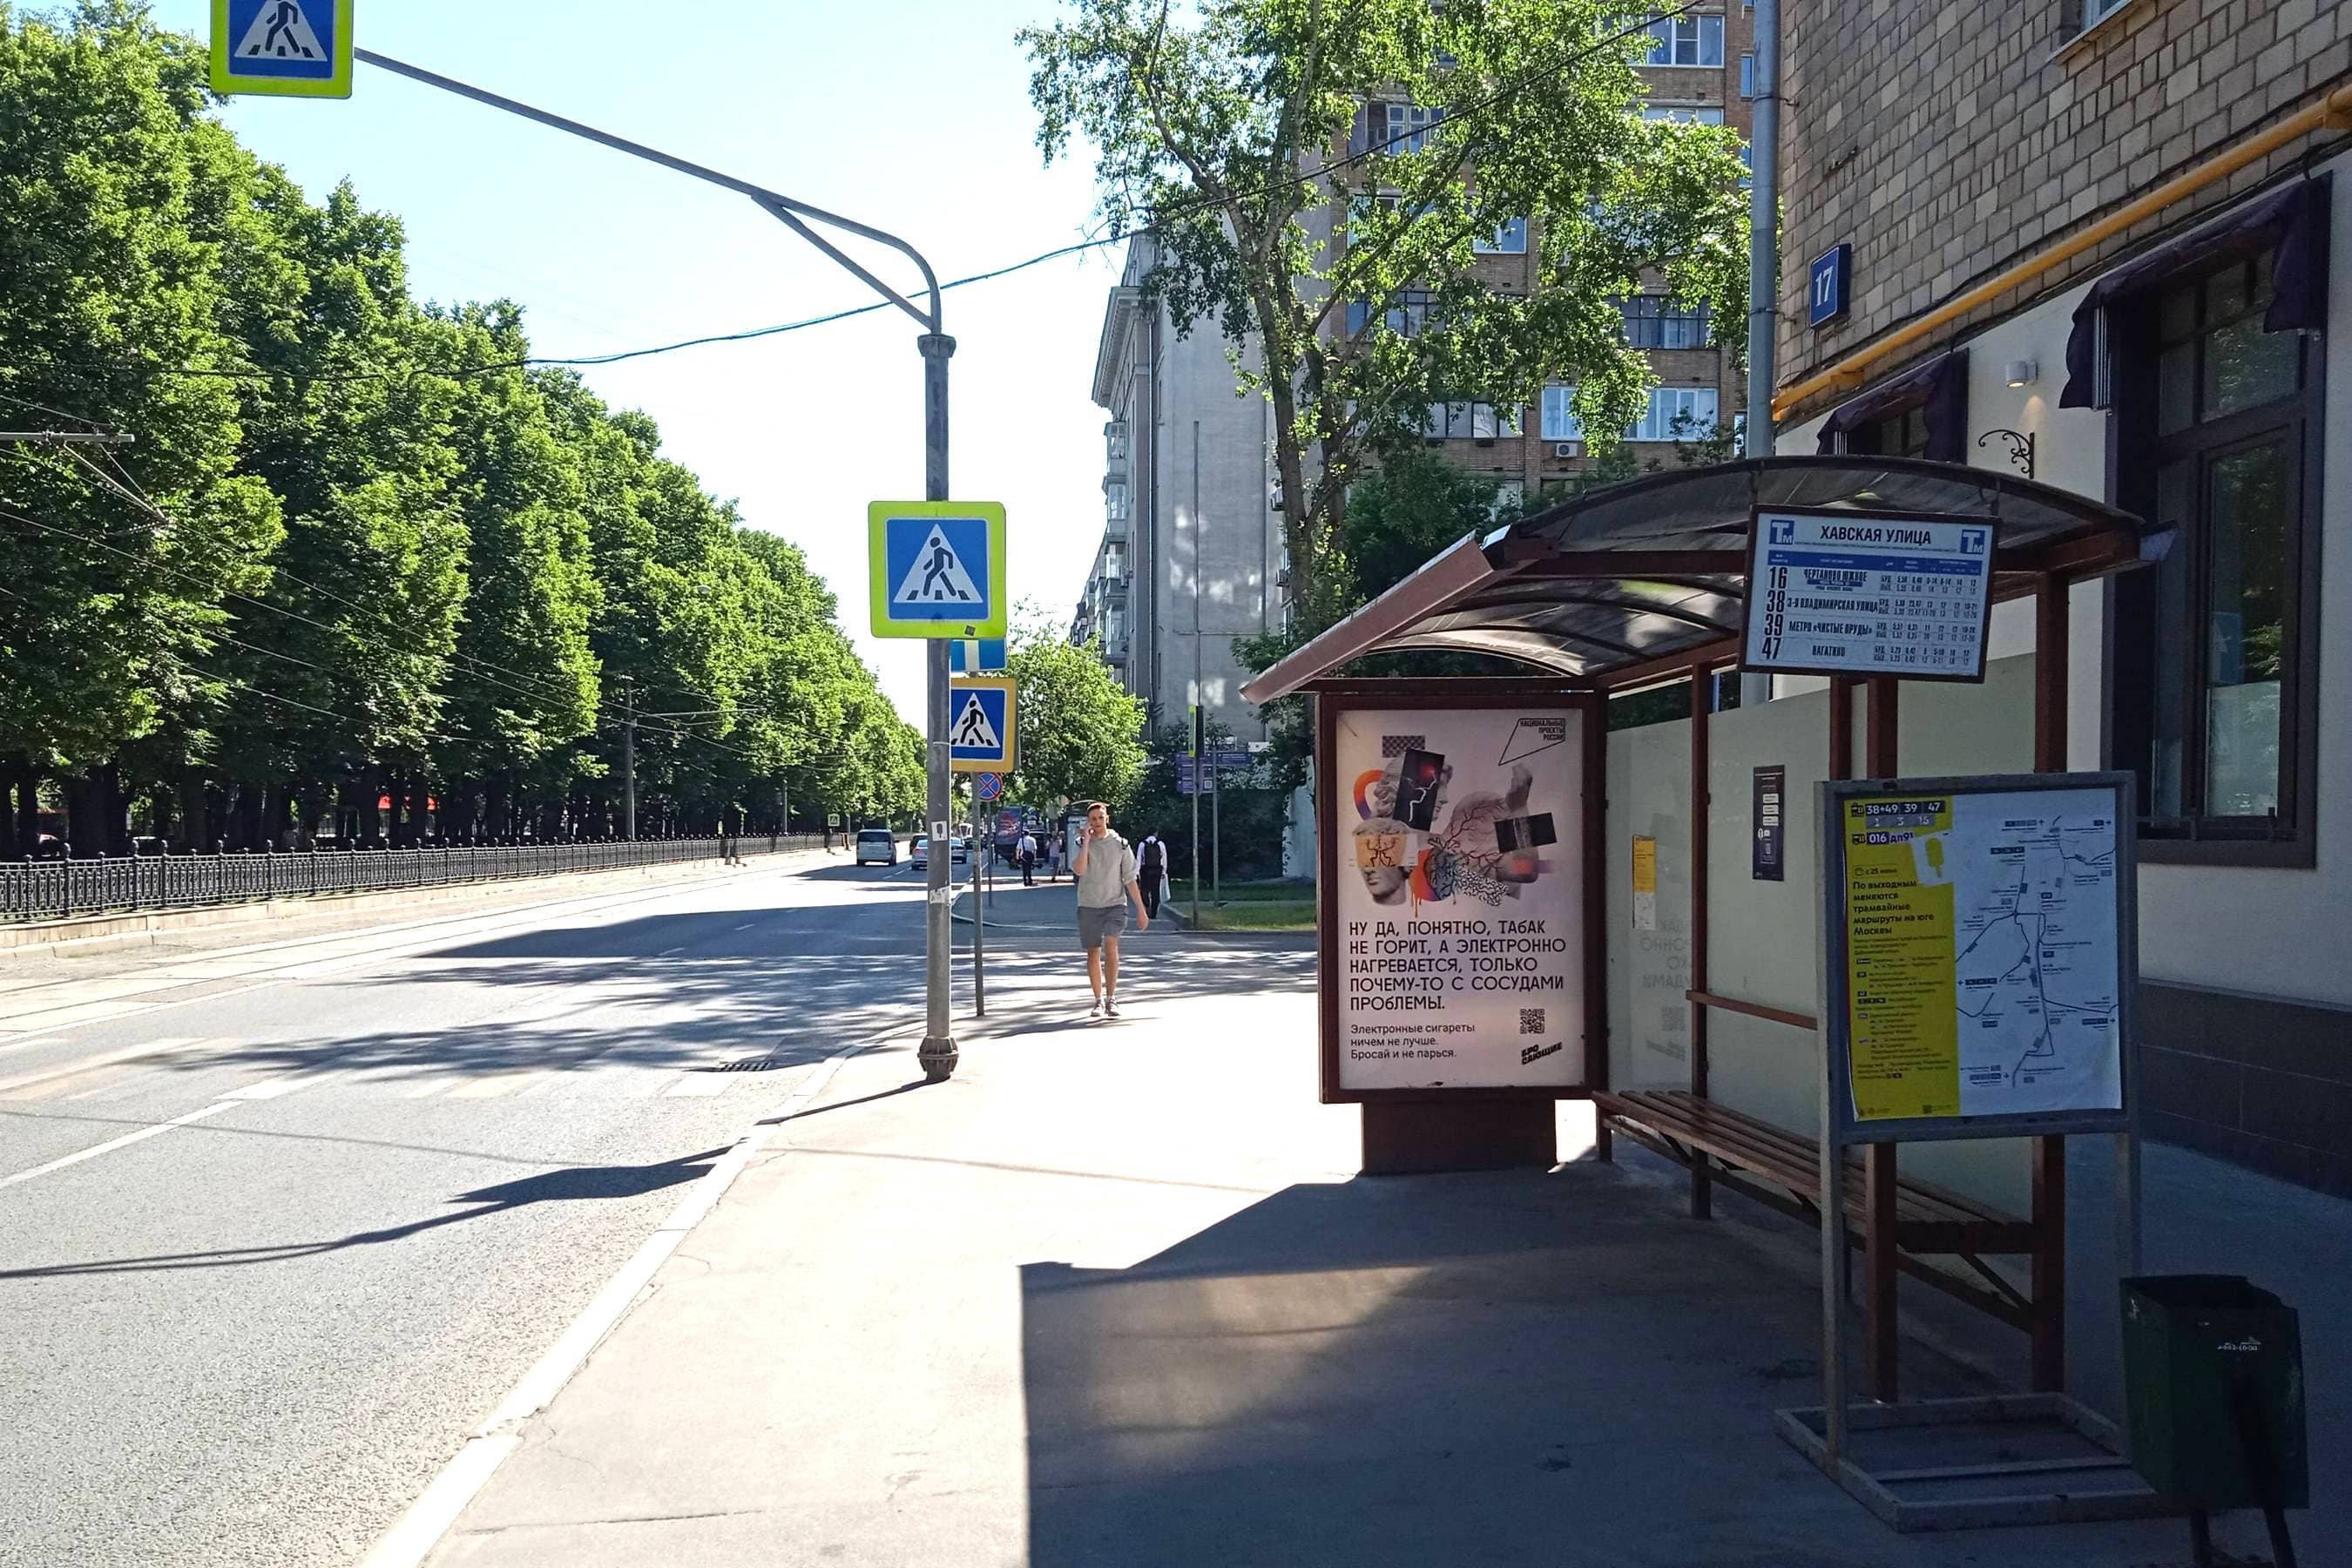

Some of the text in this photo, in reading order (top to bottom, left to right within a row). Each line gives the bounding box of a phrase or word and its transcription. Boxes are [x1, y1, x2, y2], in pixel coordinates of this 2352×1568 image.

[1815, 266, 1834, 307] 17
[1820, 525, 1931, 545] ХАВСКАЯ УЛИЦА
[1769, 566, 1788, 589] 16
[1766, 590, 1786, 613] 38
[1800, 598, 1855, 612] ВЛАДИМИРСКАЯ
[1855, 600, 1878, 612] УЛИЦА
[1764, 613, 1784, 637] 39
[1788, 621, 1812, 632] МЕТРО
[1761, 637, 1781, 660] 47
[1903, 803, 1917, 813] 39
[1928, 801, 1941, 811] 47
[1869, 833, 1888, 843] 016
[1869, 880, 1916, 889] выходным
[1854, 903, 1910, 914] трамвайные
[1854, 916, 1902, 925] маршруты
[1349, 922, 1368, 936] НУ
[1375, 922, 1399, 937] ДА,
[1408, 920, 1490, 936] ПОНЯТНО,
[1854, 927, 1892, 936] Москвы
[1349, 938, 1566, 956] НЕ ГОРИТ, А ЭЛЕКТРОННО
[1349, 956, 1538, 974] НАГРЕВАЕТСЯ, ТОЛЬКО
[1350, 976, 1564, 992] ПОЧЕМУ-ТО С СОСУДАМИ
[1350, 1024, 1475, 1035] Электронные сигареты
[1350, 1037, 1385, 1046] ничем
[1402, 1037, 1438, 1048] лучше.
[1350, 1049, 1390, 1061] Бросай
[1416, 1049, 1456, 1060] парься.
[1521, 1044, 1540, 1058] БРО
